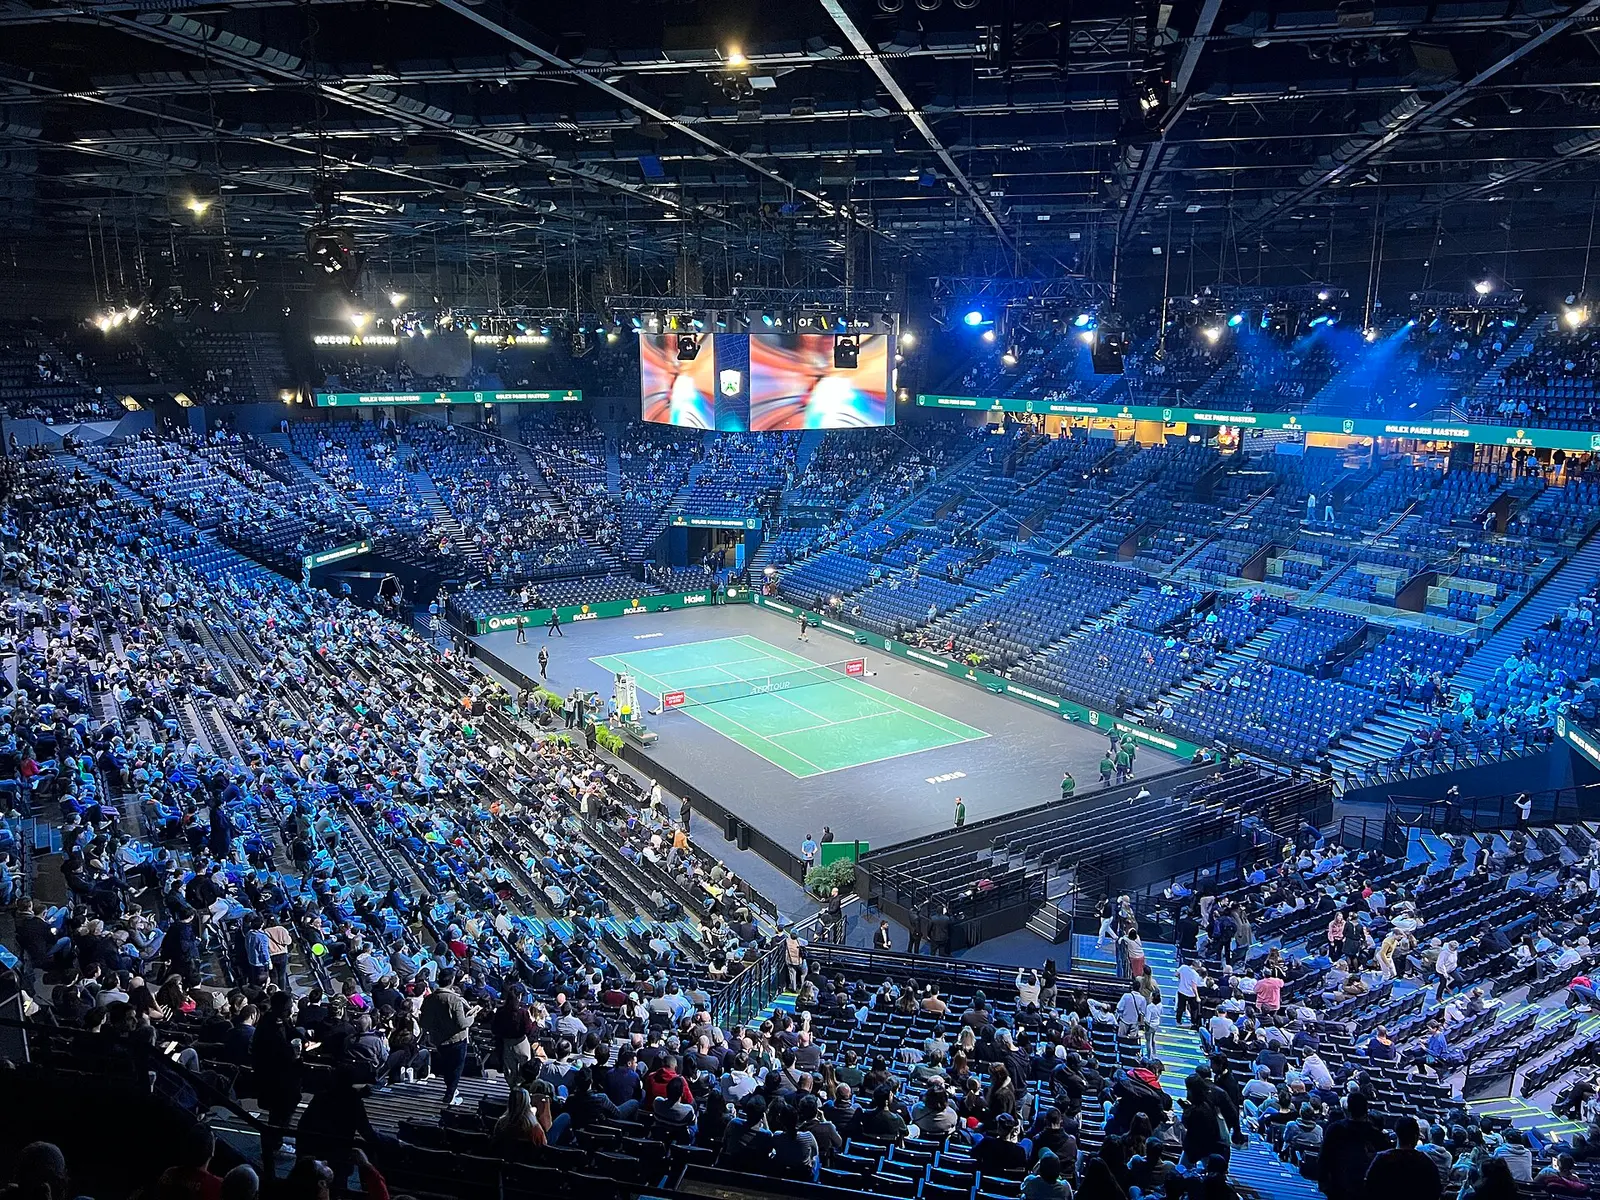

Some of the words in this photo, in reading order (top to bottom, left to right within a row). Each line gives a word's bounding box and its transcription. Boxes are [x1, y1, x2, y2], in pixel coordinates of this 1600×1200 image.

[362, 335, 399, 345] ARENA
[516, 335, 547, 344] ARENA
[1213, 414, 1229, 422] PARIS
[1230, 416, 1256, 424] MASTERS
[1385, 425, 1409, 434] ROLEX
[1410, 426, 1432, 435] PARIS
[1433, 428, 1470, 438] MASTERS
[1506, 437, 1532, 446] ROLEX
[623, 606, 647, 615] ROLEX
[573, 612, 598, 621] ROLEX
[769, 681, 791, 691] TOUR
[924, 771, 967, 784] PARIS
